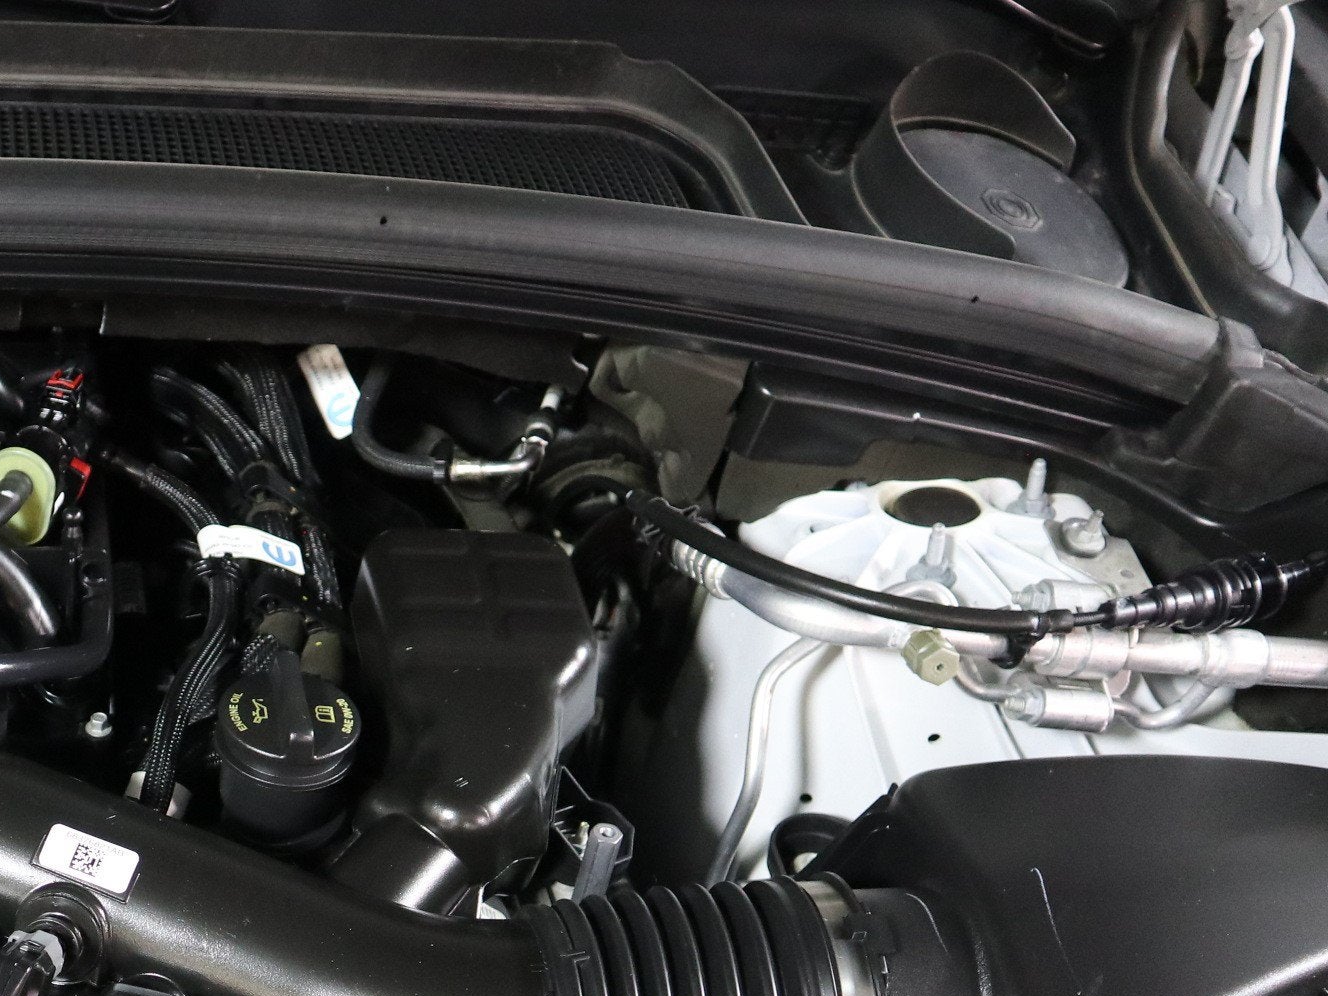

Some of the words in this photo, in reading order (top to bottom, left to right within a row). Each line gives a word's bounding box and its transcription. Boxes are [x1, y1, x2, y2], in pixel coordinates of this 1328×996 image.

[229, 692, 244, 703] OIL
[228, 704, 249, 732] ENGINE
[341, 718, 354, 734] SAE
